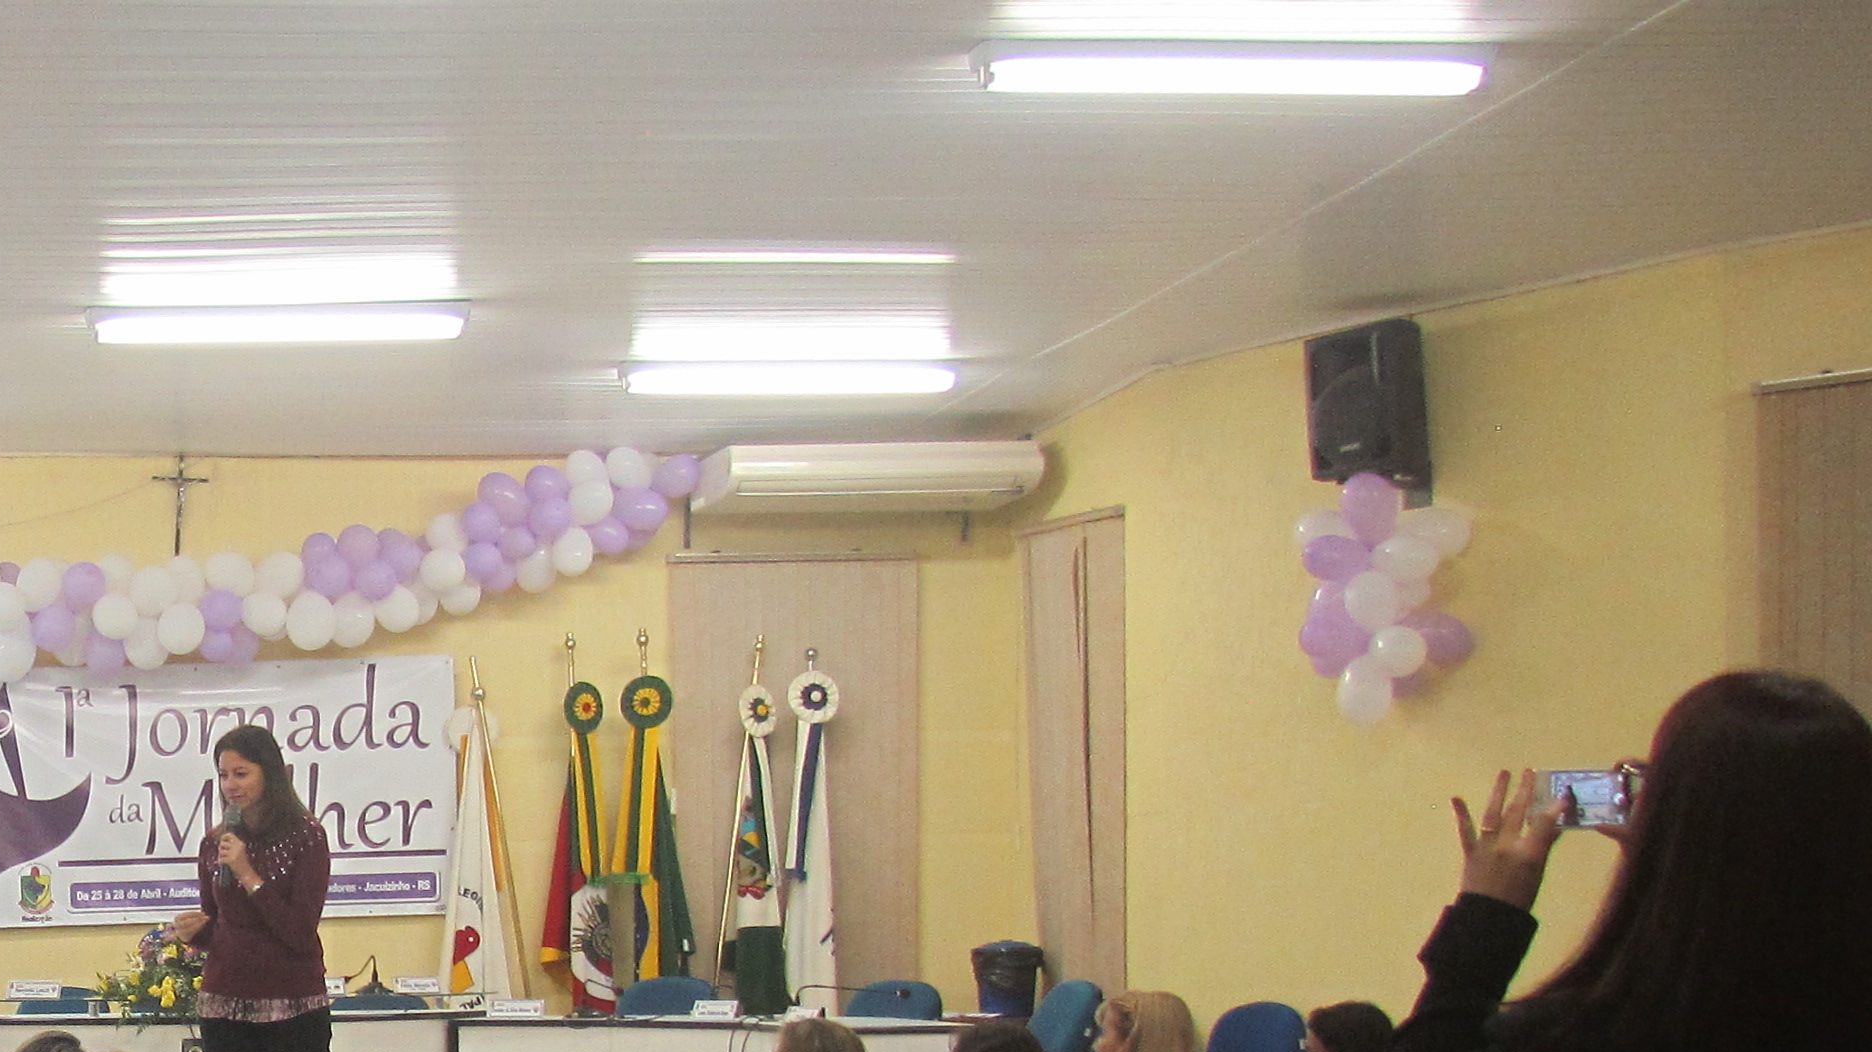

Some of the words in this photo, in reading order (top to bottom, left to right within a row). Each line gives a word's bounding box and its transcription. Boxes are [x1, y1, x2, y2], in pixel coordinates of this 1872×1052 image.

[109, 794, 143, 824] da
[141, 762, 433, 855] Mher
[76, 890, 89, 901] De
[91, 890, 103, 900] 25
[113, 889, 124, 900] 28
[127, 889, 138, 899] de
[140, 888, 161, 899] Abril
[417, 880, 430, 890] RS
